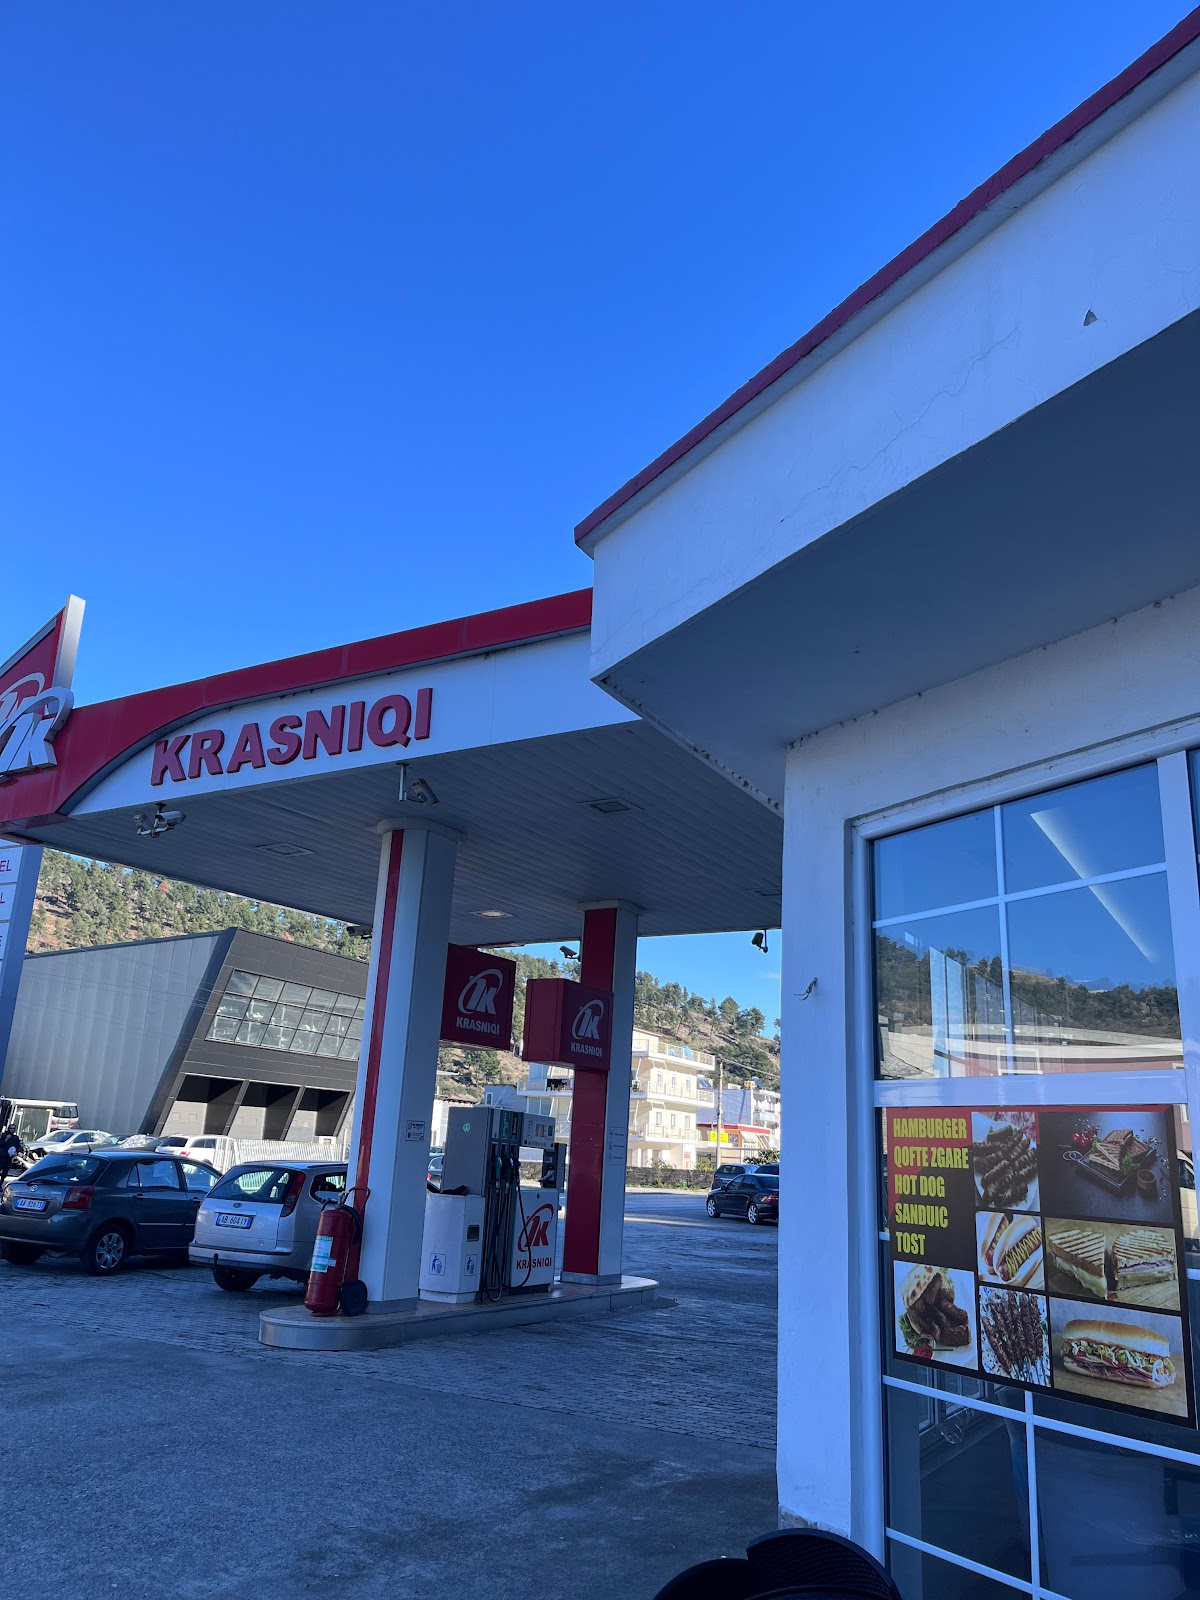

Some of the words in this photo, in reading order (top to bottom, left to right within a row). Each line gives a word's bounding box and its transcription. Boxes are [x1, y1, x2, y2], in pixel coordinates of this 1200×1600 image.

[150, 687, 433, 786] KRASNIQI
[456, 1016, 500, 1035] KRASNIQI
[570, 1042, 603, 1057] KRASNIQI
[893, 1117, 968, 1139] HAMBURGER
[893, 1145, 929, 1168] QOFTE
[930, 1146, 970, 1169] ZGARE
[894, 1173, 917, 1196] HOT
[919, 1175, 946, 1198] DOG
[894, 1202, 949, 1228] SANDUIC
[895, 1231, 926, 1256] TOST
